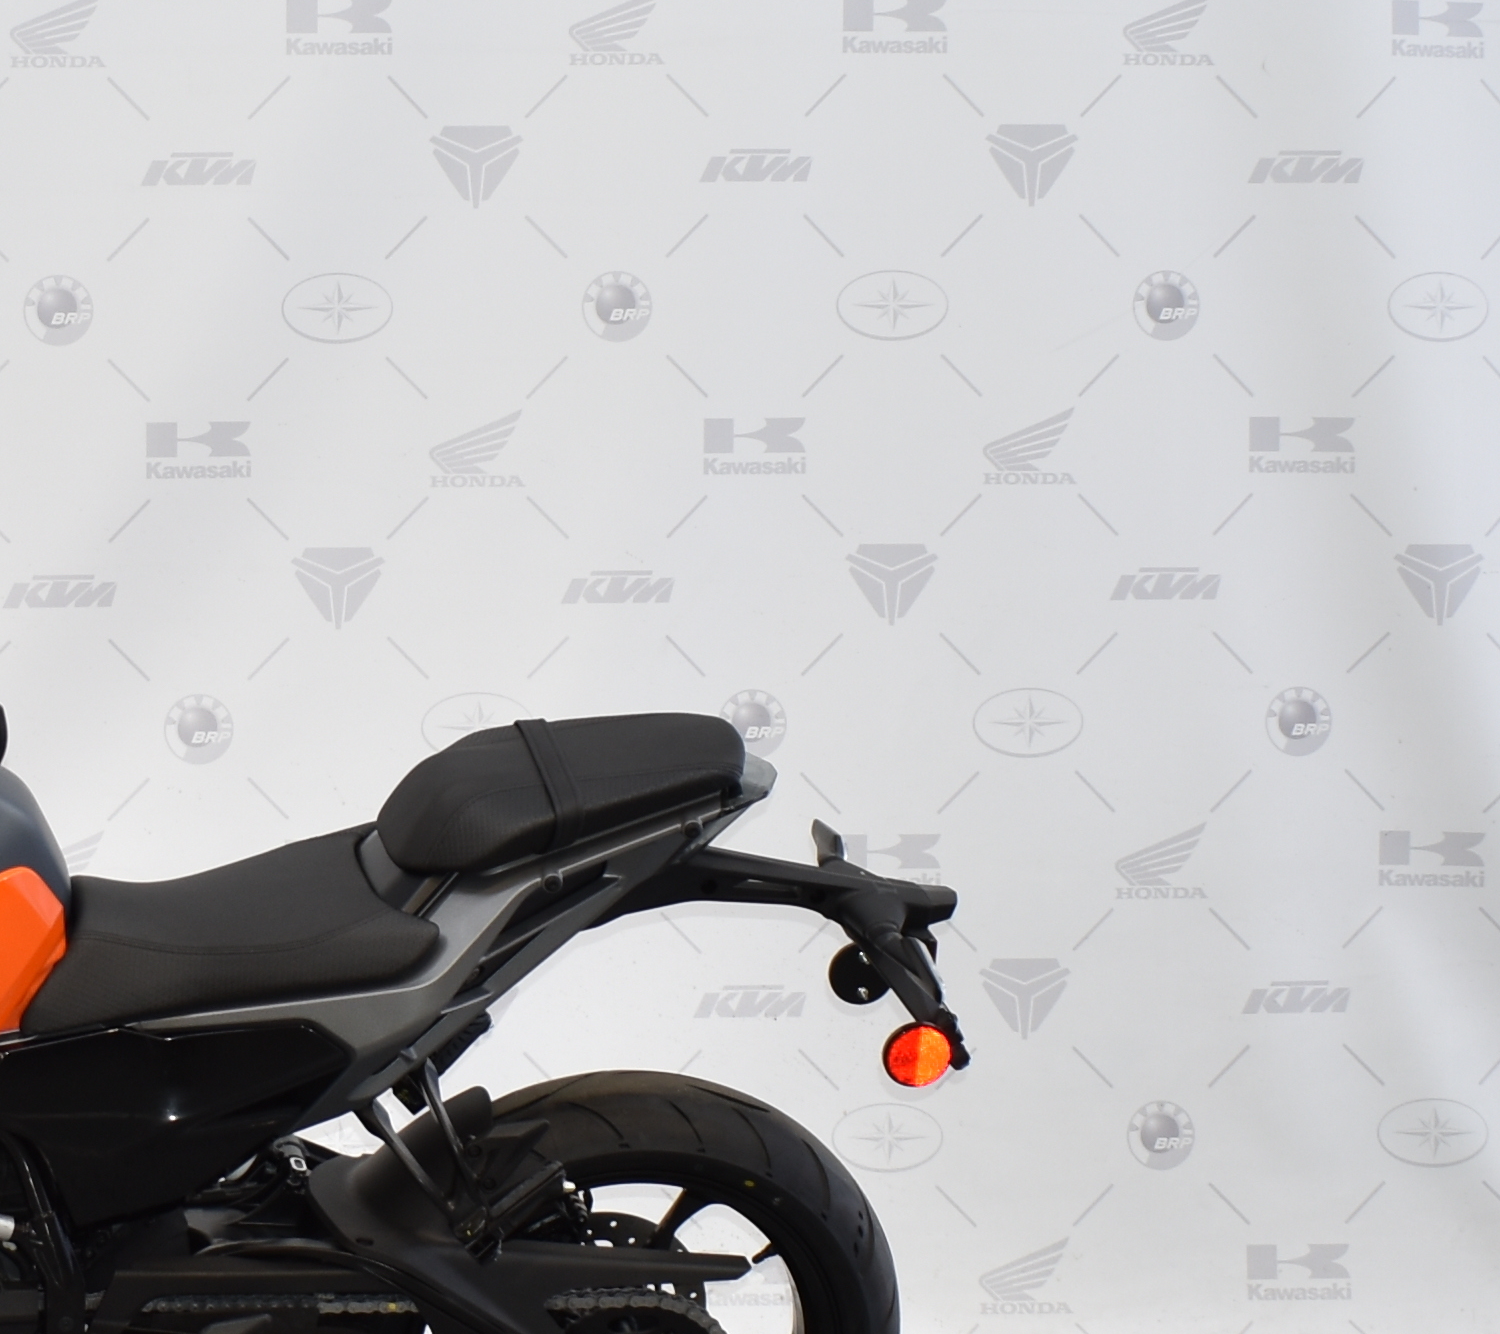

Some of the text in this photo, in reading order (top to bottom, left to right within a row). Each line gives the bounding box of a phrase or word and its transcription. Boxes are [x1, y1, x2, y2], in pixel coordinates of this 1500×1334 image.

[286, 37, 393, 55] Kawasaki
[843, 36, 947, 54] Kawasaki
[1392, 39, 1484, 59] Kawasaki
[11, 53, 105, 68] HONDA
[570, 50, 664, 66] HONDA
[1124, 50, 1215, 66] HONDA
[141, 152, 256, 186] KTM
[700, 149, 811, 182] KTM
[1248, 150, 1363, 183] KTM
[52, 311, 91, 324] BRP
[1161, 307, 1195, 320] BRP
[146, 457, 251, 479] Kawasaki
[703, 457, 806, 475] Kawasaki
[1249, 452, 1357, 475] Kawasaki
[430, 473, 525, 488] HONDA
[984, 469, 1076, 485] HONDA
[4, 574, 117, 608] KTM
[562, 570, 674, 603] KTM
[1110, 567, 1220, 600] KTM
[192, 730, 231, 743] BRP
[1379, 866, 1489, 889] Kawasaki
[1116, 885, 1208, 899] HONDA
[695, 985, 807, 1021] KTM
[1242, 981, 1351, 1014] KTM
[1247, 1282, 1351, 1300] Kawasaki
[981, 1299, 1073, 1315] HONDA
